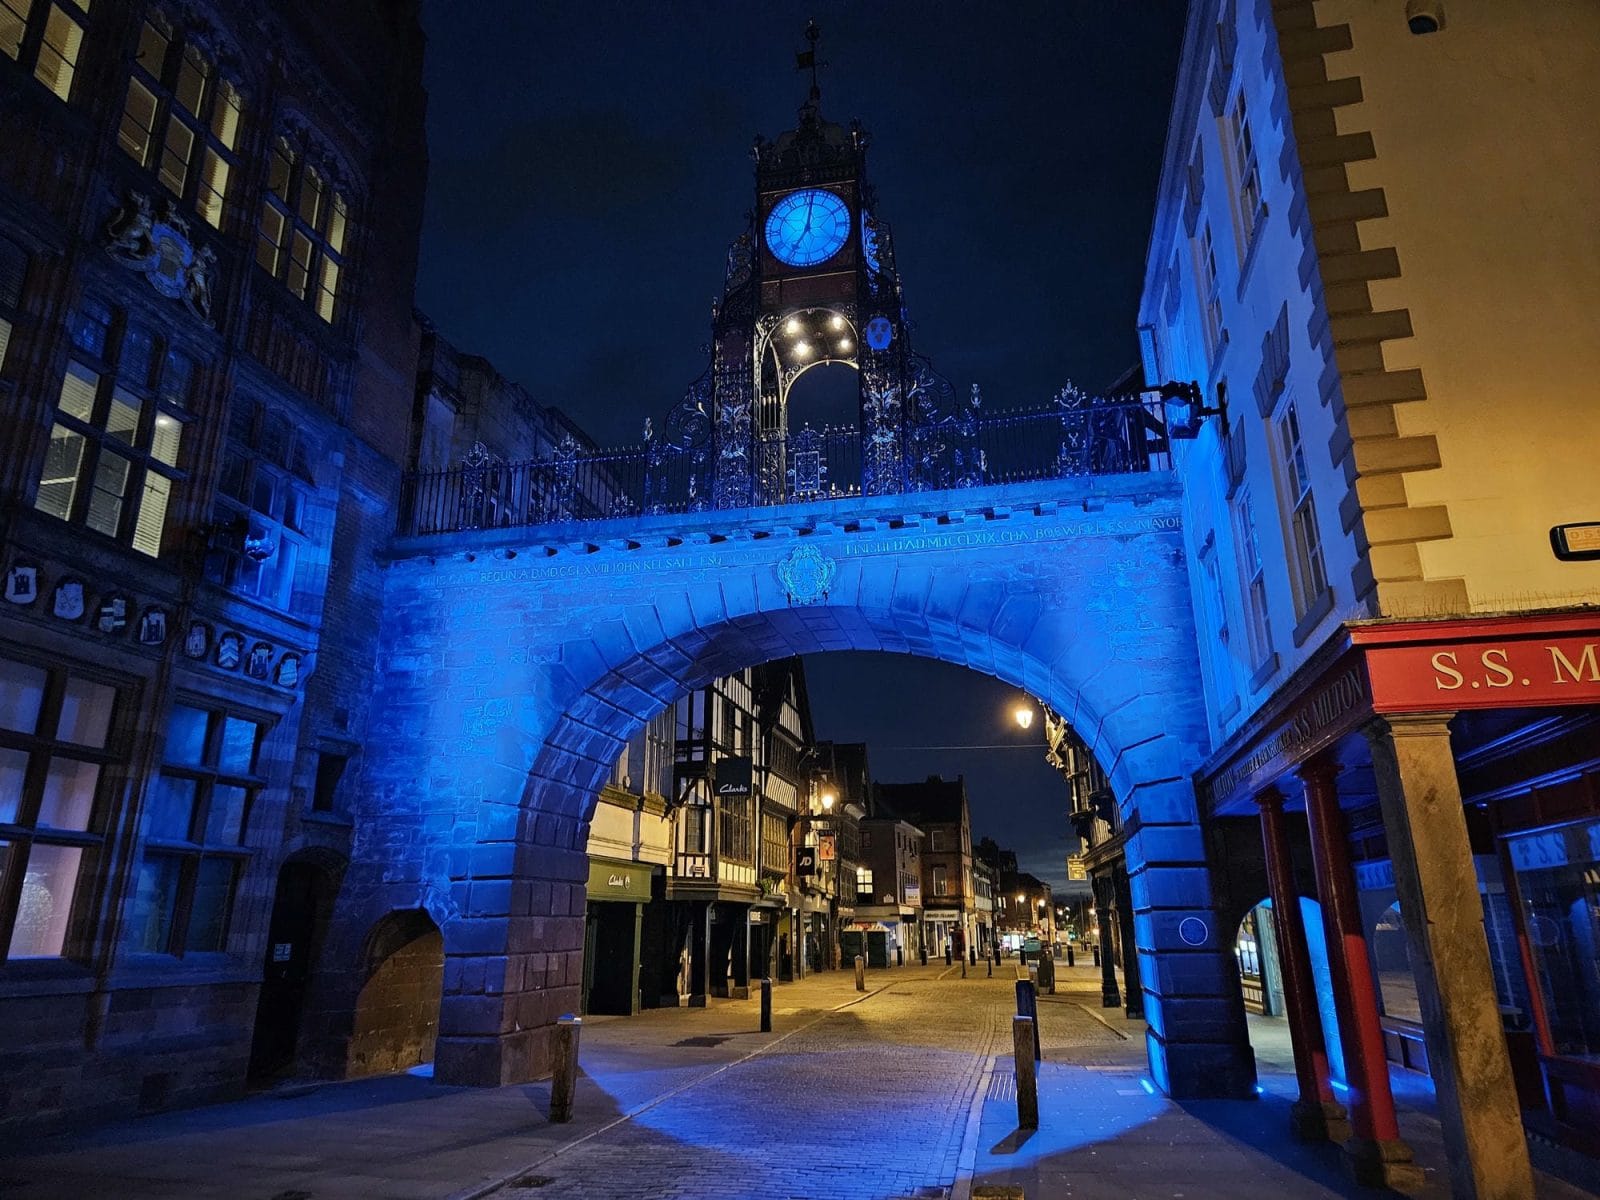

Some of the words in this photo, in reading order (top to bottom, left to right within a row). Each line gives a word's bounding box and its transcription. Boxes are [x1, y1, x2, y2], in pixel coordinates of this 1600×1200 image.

[480, 569, 517, 582] BEGUN
[613, 560, 641, 573] JOHN
[1431, 648, 1530, 690] S.S.
[1312, 664, 1364, 731] MILTON
[720, 783, 748, 793] Clarks
[799, 856, 812, 867] JD
